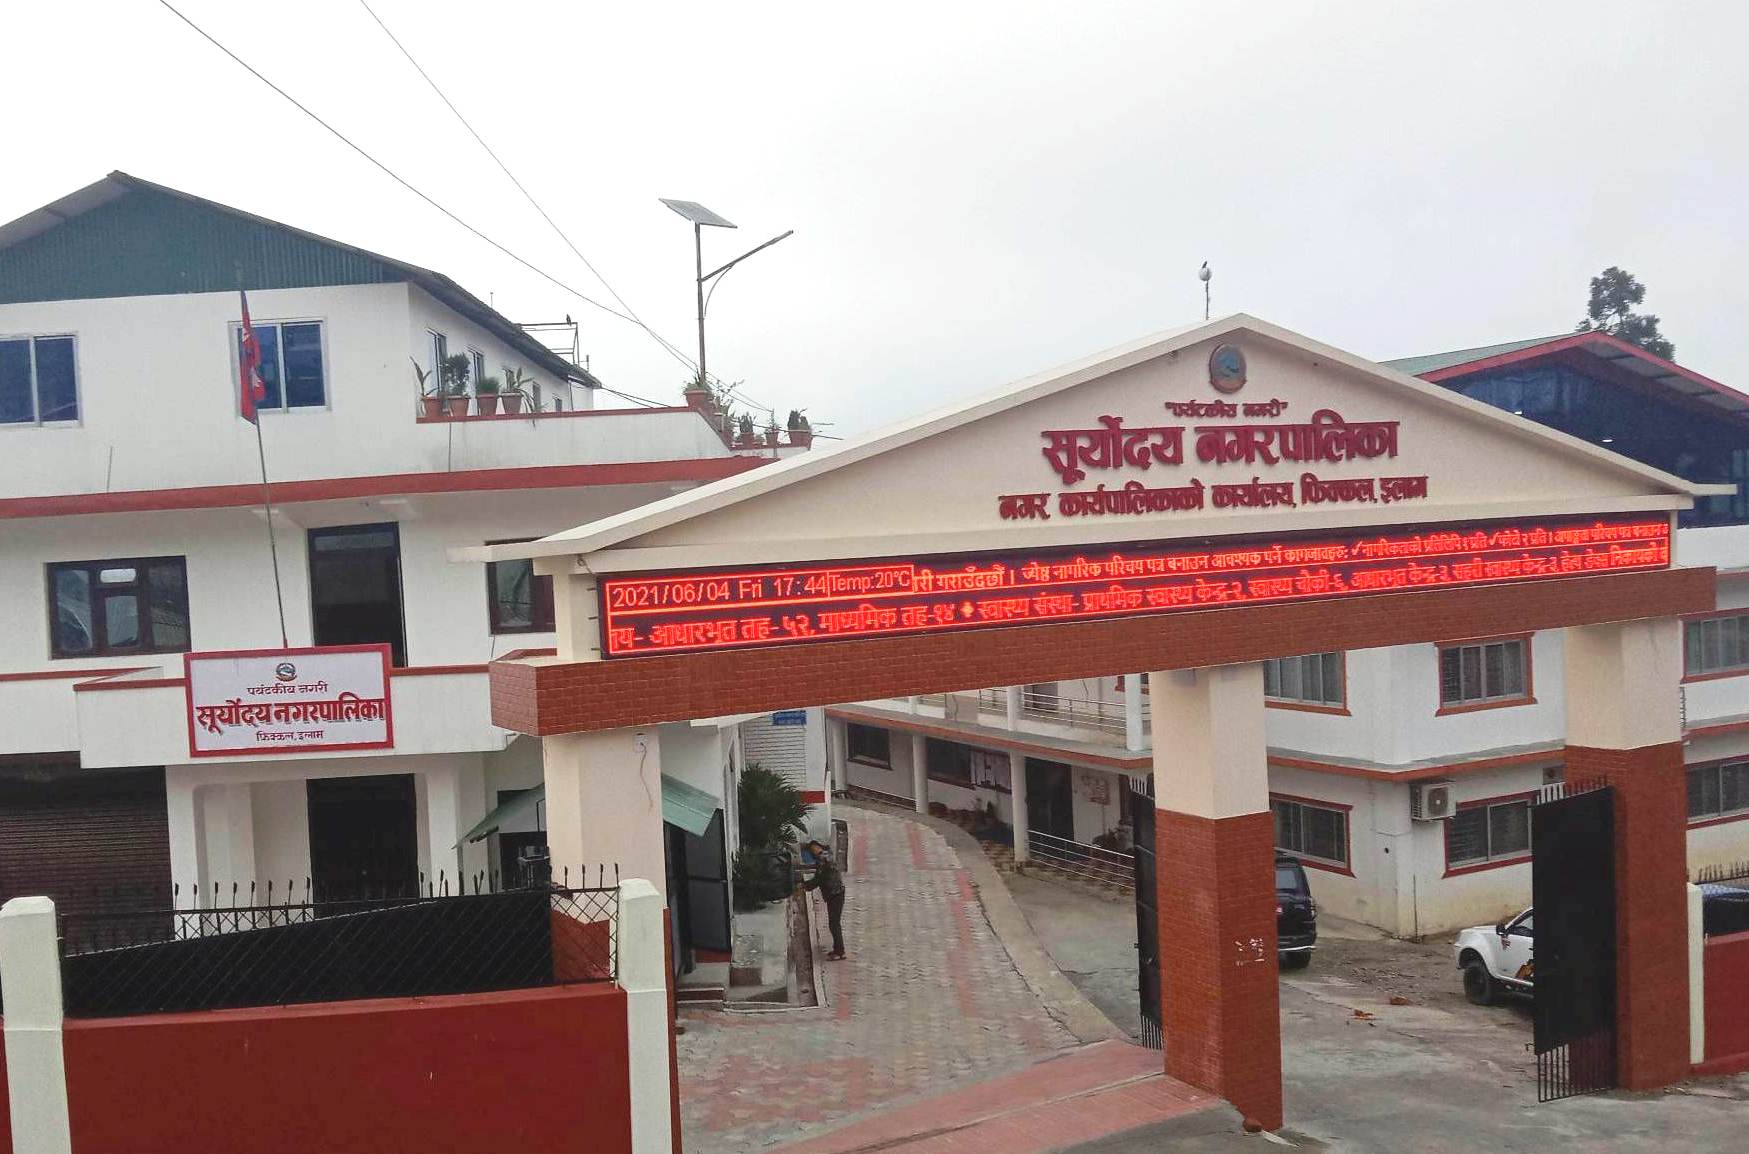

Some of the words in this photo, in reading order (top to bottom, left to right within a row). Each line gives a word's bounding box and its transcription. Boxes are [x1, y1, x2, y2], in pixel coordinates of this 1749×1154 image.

[1041, 416, 1186, 485] सूर्योदय
[1195, 409, 1400, 465] नगरपालिका
[999, 493, 1051, 520] नगर
[1059, 480, 1204, 516] कार्यपालिकाको
[1211, 477, 1297, 509] कार्यालय,
[831, 570, 911, 593] Temp:20°C
[1053, 558, 1101, 580] नागरिक
[1105, 555, 1143, 576] परिचय
[1168, 554, 1208, 571] बनाउन
[613, 580, 730, 608] 2021/06/04
[739, 581, 763, 600] Fri
[774, 577, 826, 597] 17:44
[196, 698, 272, 734] सूर्योदय
[274, 692, 384, 724] नगरपालिका
